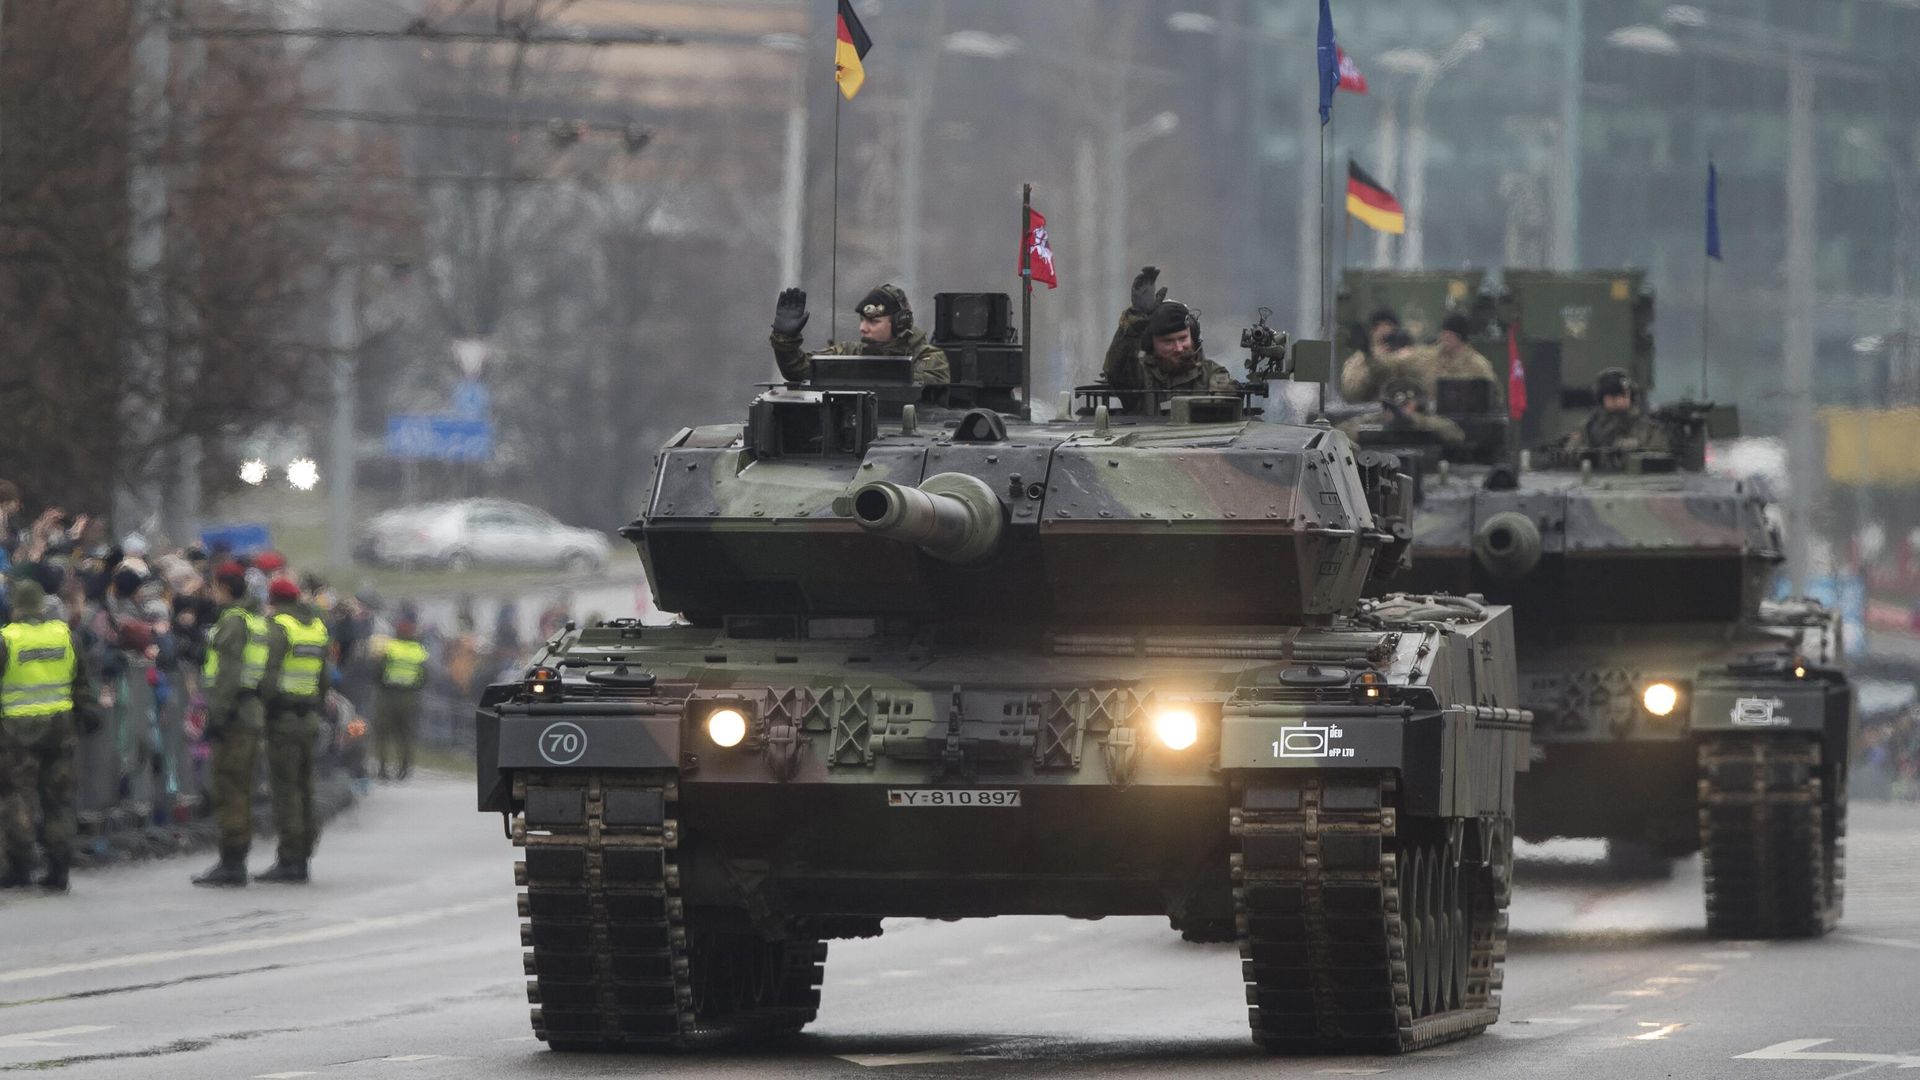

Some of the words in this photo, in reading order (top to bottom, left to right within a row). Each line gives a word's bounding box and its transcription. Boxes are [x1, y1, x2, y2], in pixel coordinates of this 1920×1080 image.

[548, 733, 578, 752] 70
[1272, 741, 1279, 757] 1
[1342, 748, 1354, 757] LTU
[978, 792, 1018, 804] 897
